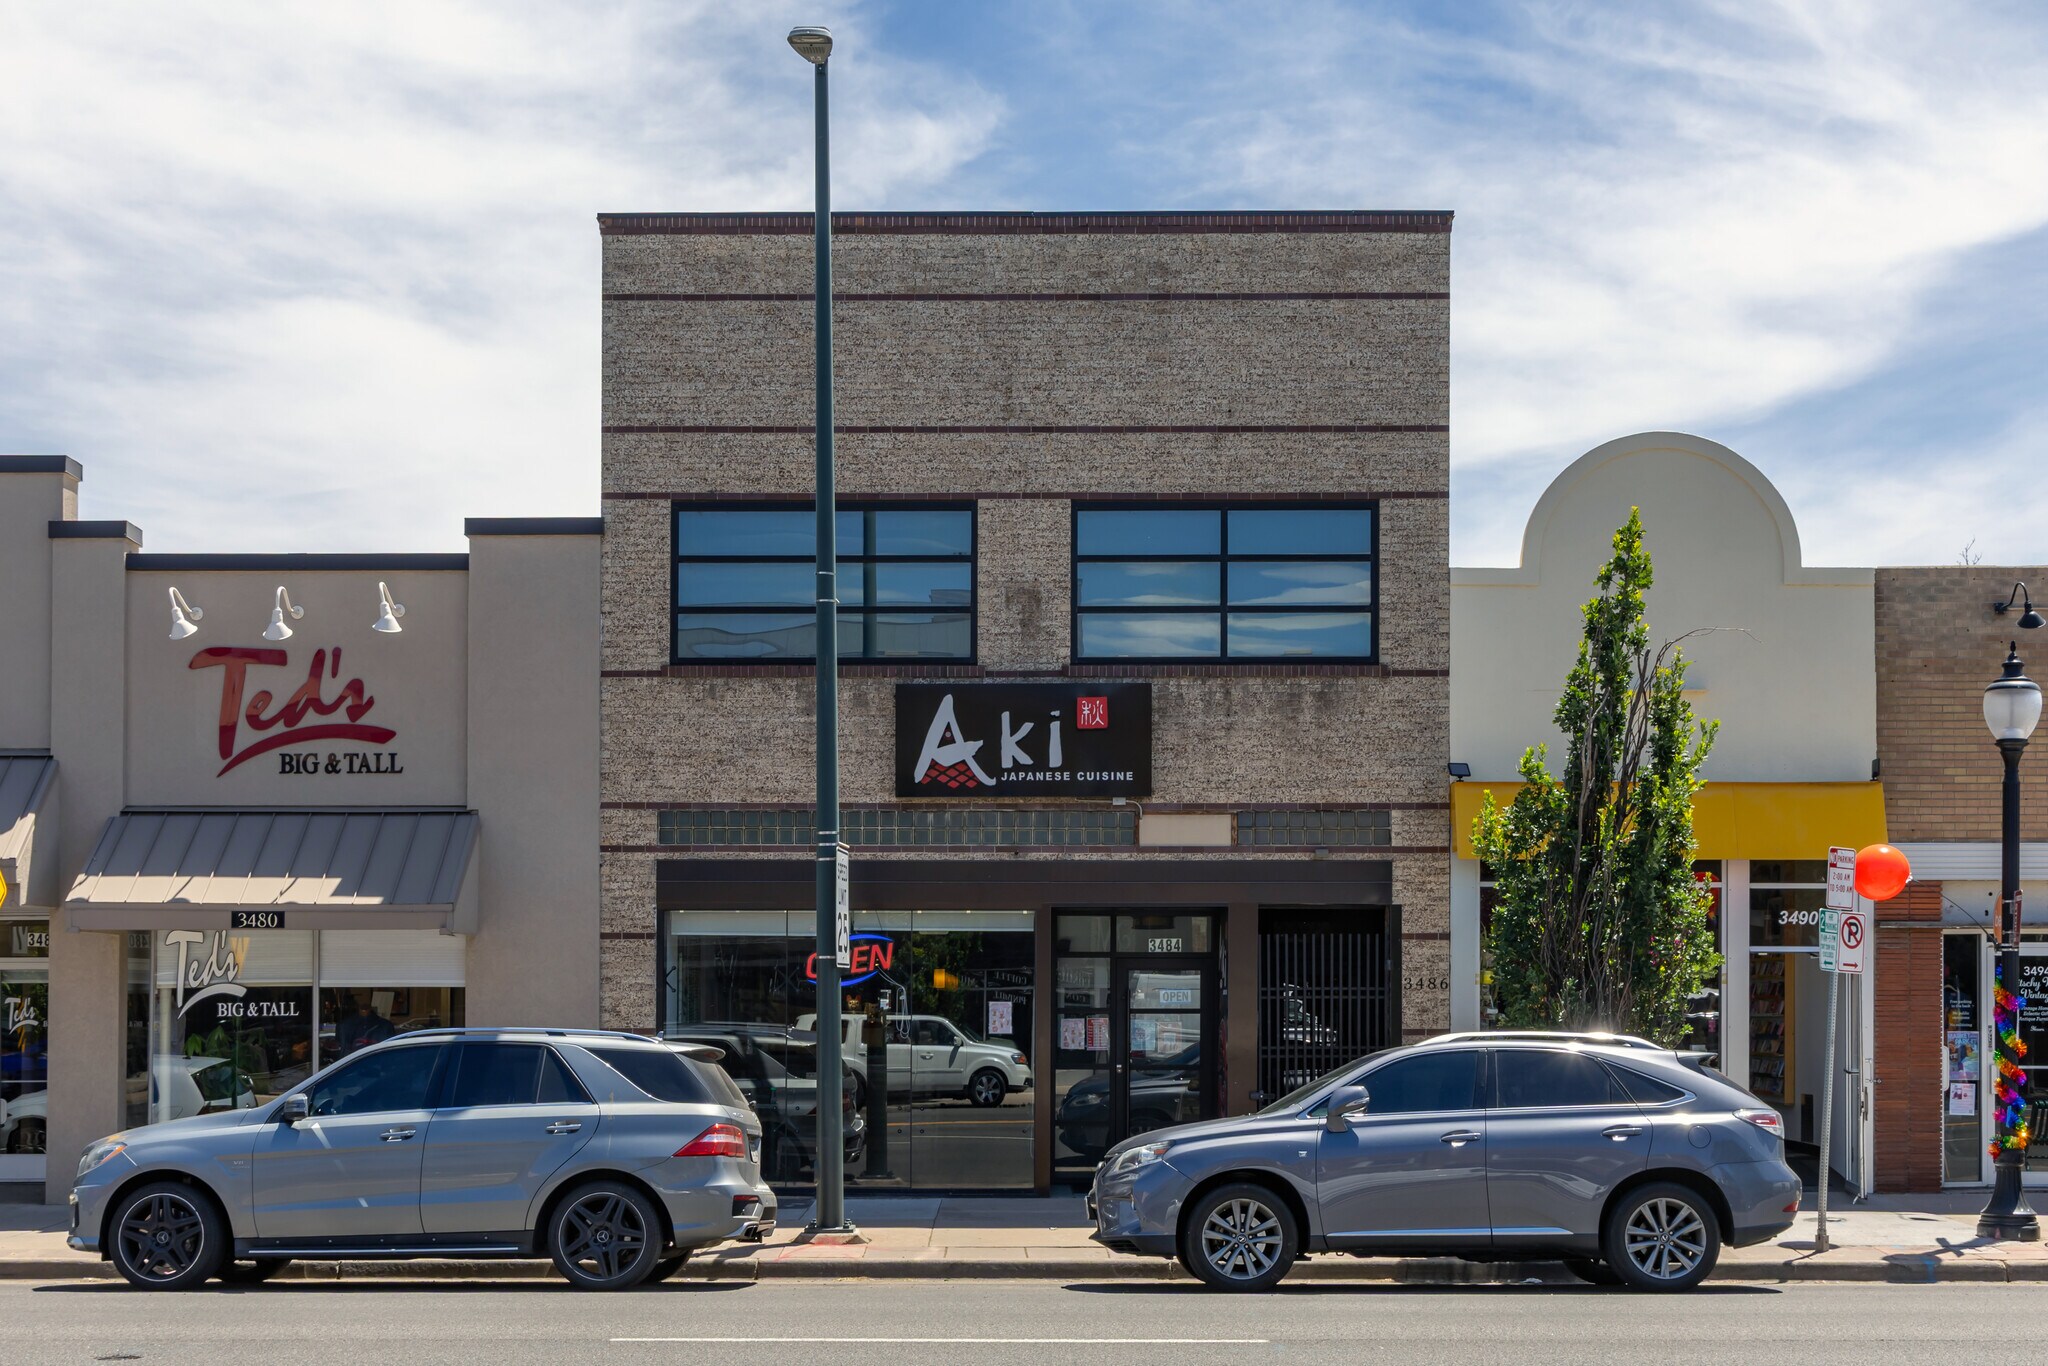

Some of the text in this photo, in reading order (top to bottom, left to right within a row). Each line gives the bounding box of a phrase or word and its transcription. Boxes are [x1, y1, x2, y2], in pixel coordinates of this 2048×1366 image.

[188, 647, 375, 760] Ted's
[914, 694, 1062, 787] Aki
[279, 752, 404, 775] BIG & TALL
[1001, 771, 1134, 782] JAPANESE CUISINE
[1838, 855, 1854, 866] PARKING
[1833, 871, 1843, 881] 2:00
[238, 912, 278, 928] 3480
[1778, 910, 1819, 926] 3490
[838, 912, 848, 954] 25
[1149, 939, 1181, 952] 3484
[805, 943, 894, 979] OEN
[165, 930, 239, 1008] Ted's
[2023, 966, 2048, 976] 3494
[1404, 977, 1449, 990] 3486
[2018, 977, 2041, 992] tschy
[1162, 991, 1190, 1002] OPEN
[2020, 988, 2048, 1003] Vintag
[4, 997, 36, 1030] Ted's
[217, 1002, 300, 1017] BIG & TALL
